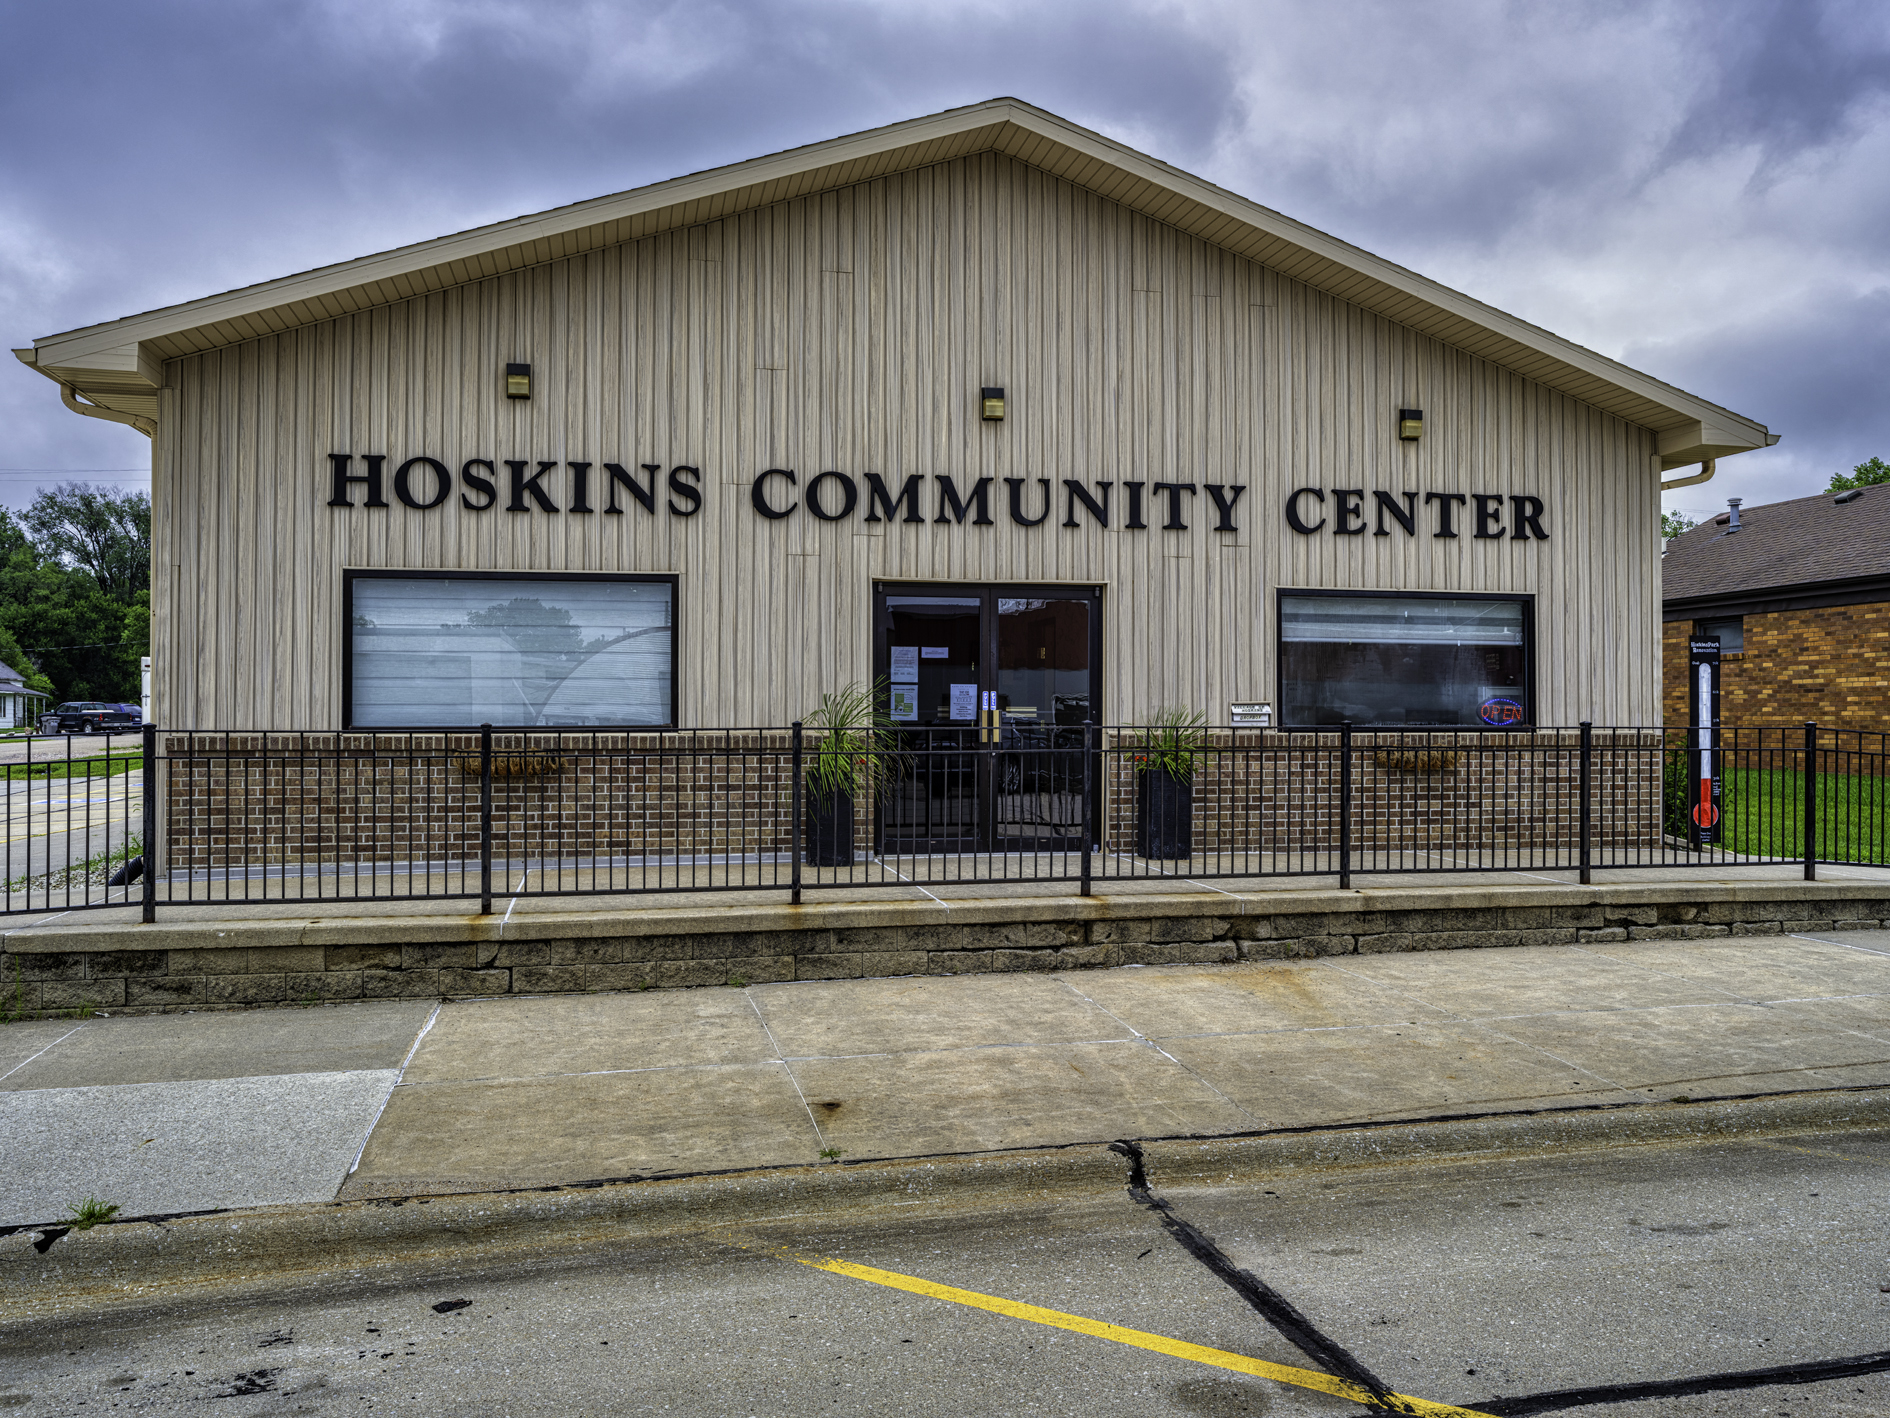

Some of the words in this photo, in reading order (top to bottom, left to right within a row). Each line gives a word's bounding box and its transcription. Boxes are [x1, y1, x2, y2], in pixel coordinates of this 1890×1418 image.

[327, 453, 702, 519] HOSKINS
[751, 468, 1247, 534] COMMUNITY
[1285, 487, 1550, 542] CENTER
[1481, 704, 1522, 720] OPEN
